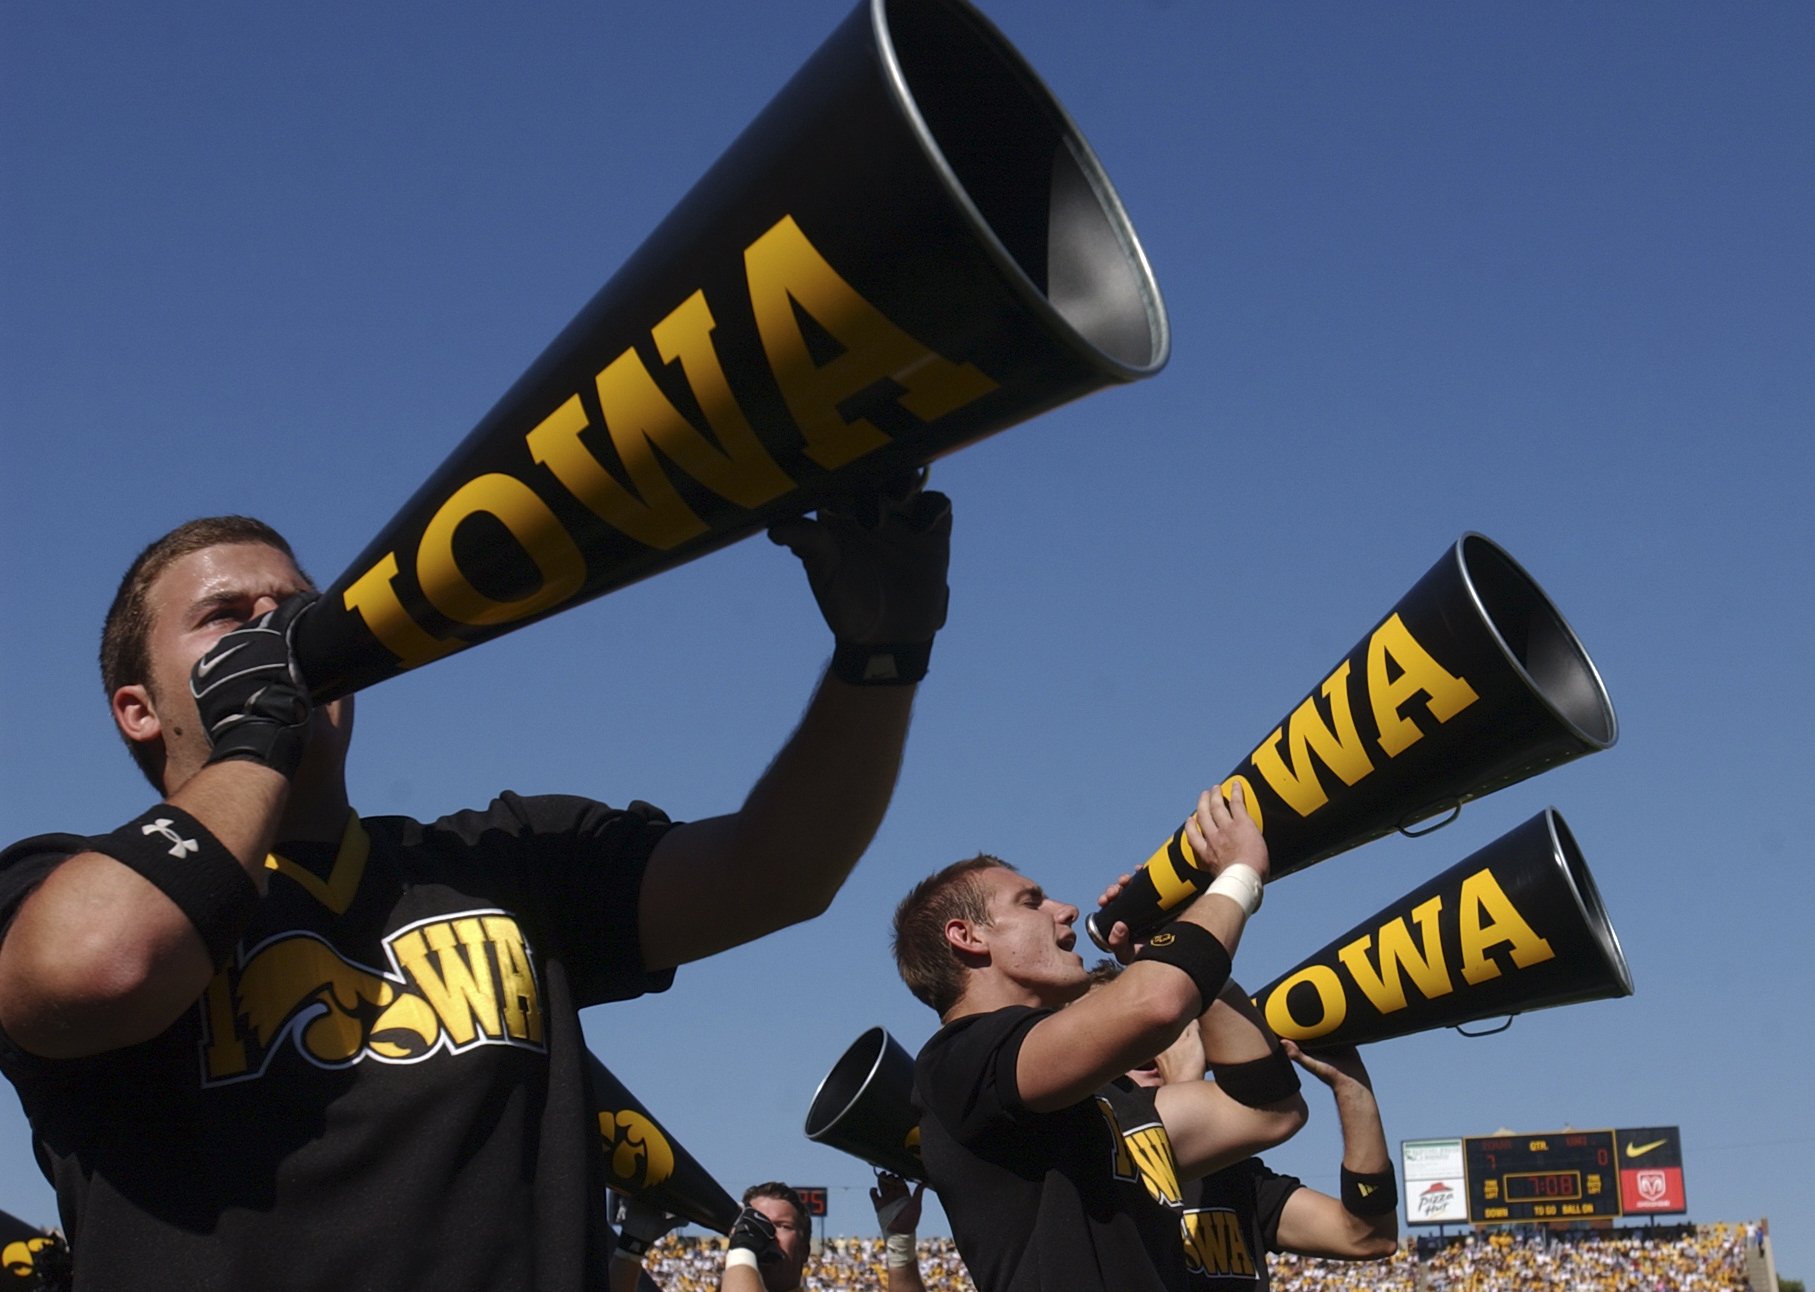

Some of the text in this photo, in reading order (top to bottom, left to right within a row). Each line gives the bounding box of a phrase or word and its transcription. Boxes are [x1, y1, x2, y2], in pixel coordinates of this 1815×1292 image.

[343, 213, 1001, 670] IOWA
[1251, 867, 1556, 1041] OWA
[1597, 1148, 1608, 1166] 0
